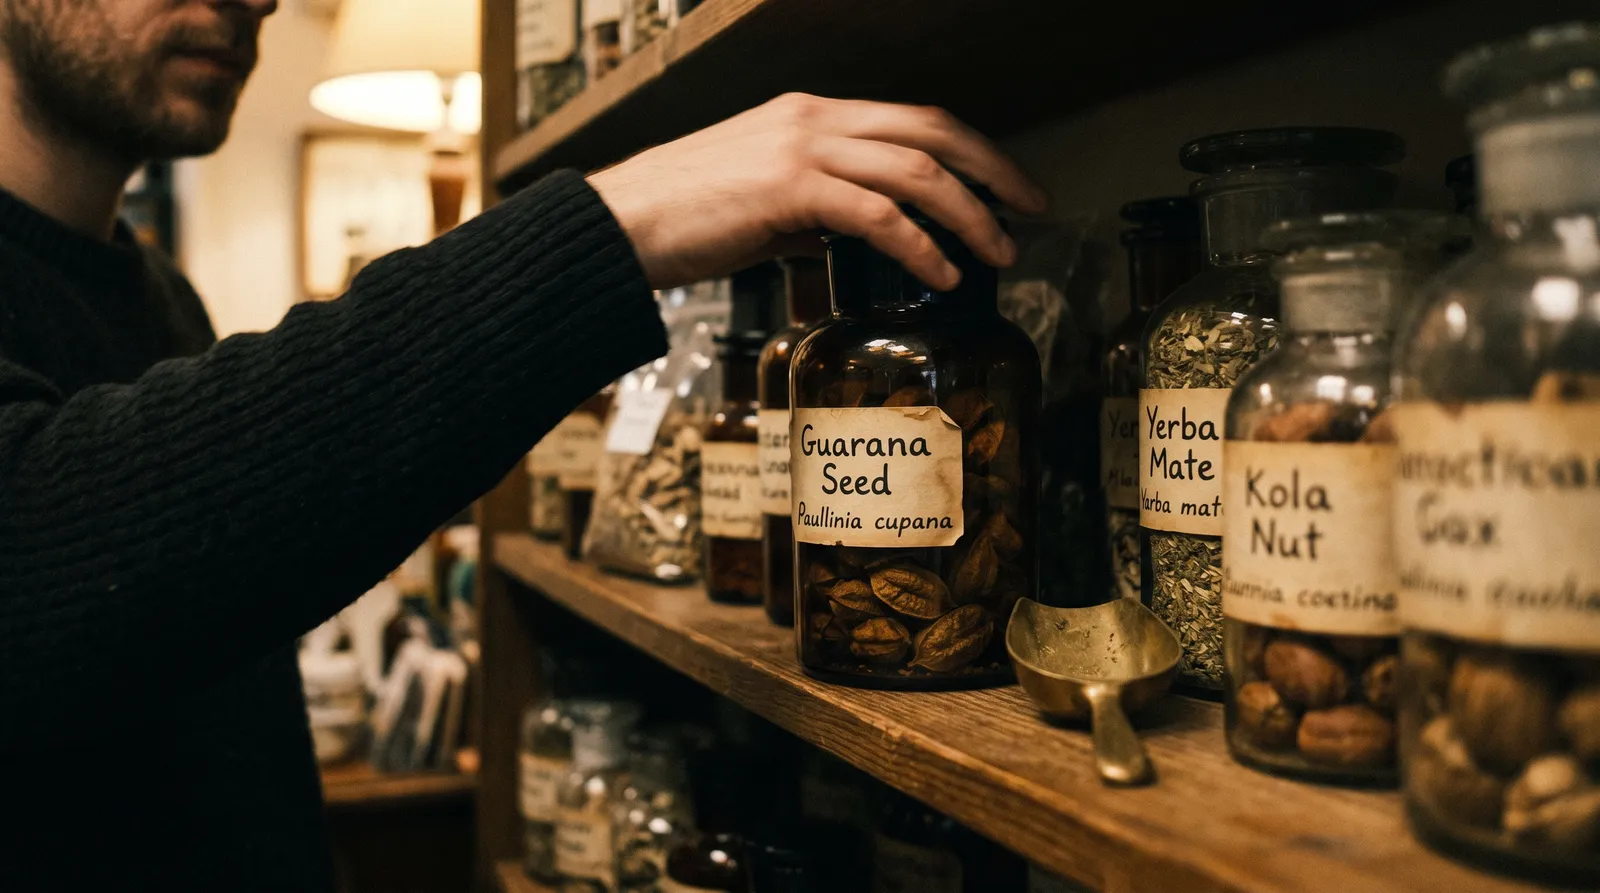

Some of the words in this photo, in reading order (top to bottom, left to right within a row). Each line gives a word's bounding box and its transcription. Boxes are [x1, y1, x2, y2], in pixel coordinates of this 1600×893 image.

[801, 424, 932, 457] Guarana
[1146, 405, 1219, 441] Yerba
[821, 462, 892, 496] Seed
[1150, 446, 1215, 481] Mate
[1140, 487, 1171, 514] Yarba
[1180, 495, 1224, 517] mat
[1244, 466, 1332, 512] Kola
[797, 501, 863, 530] Paullinia
[874, 515, 954, 538] cupana
[1250, 517, 1324, 562] Nut
